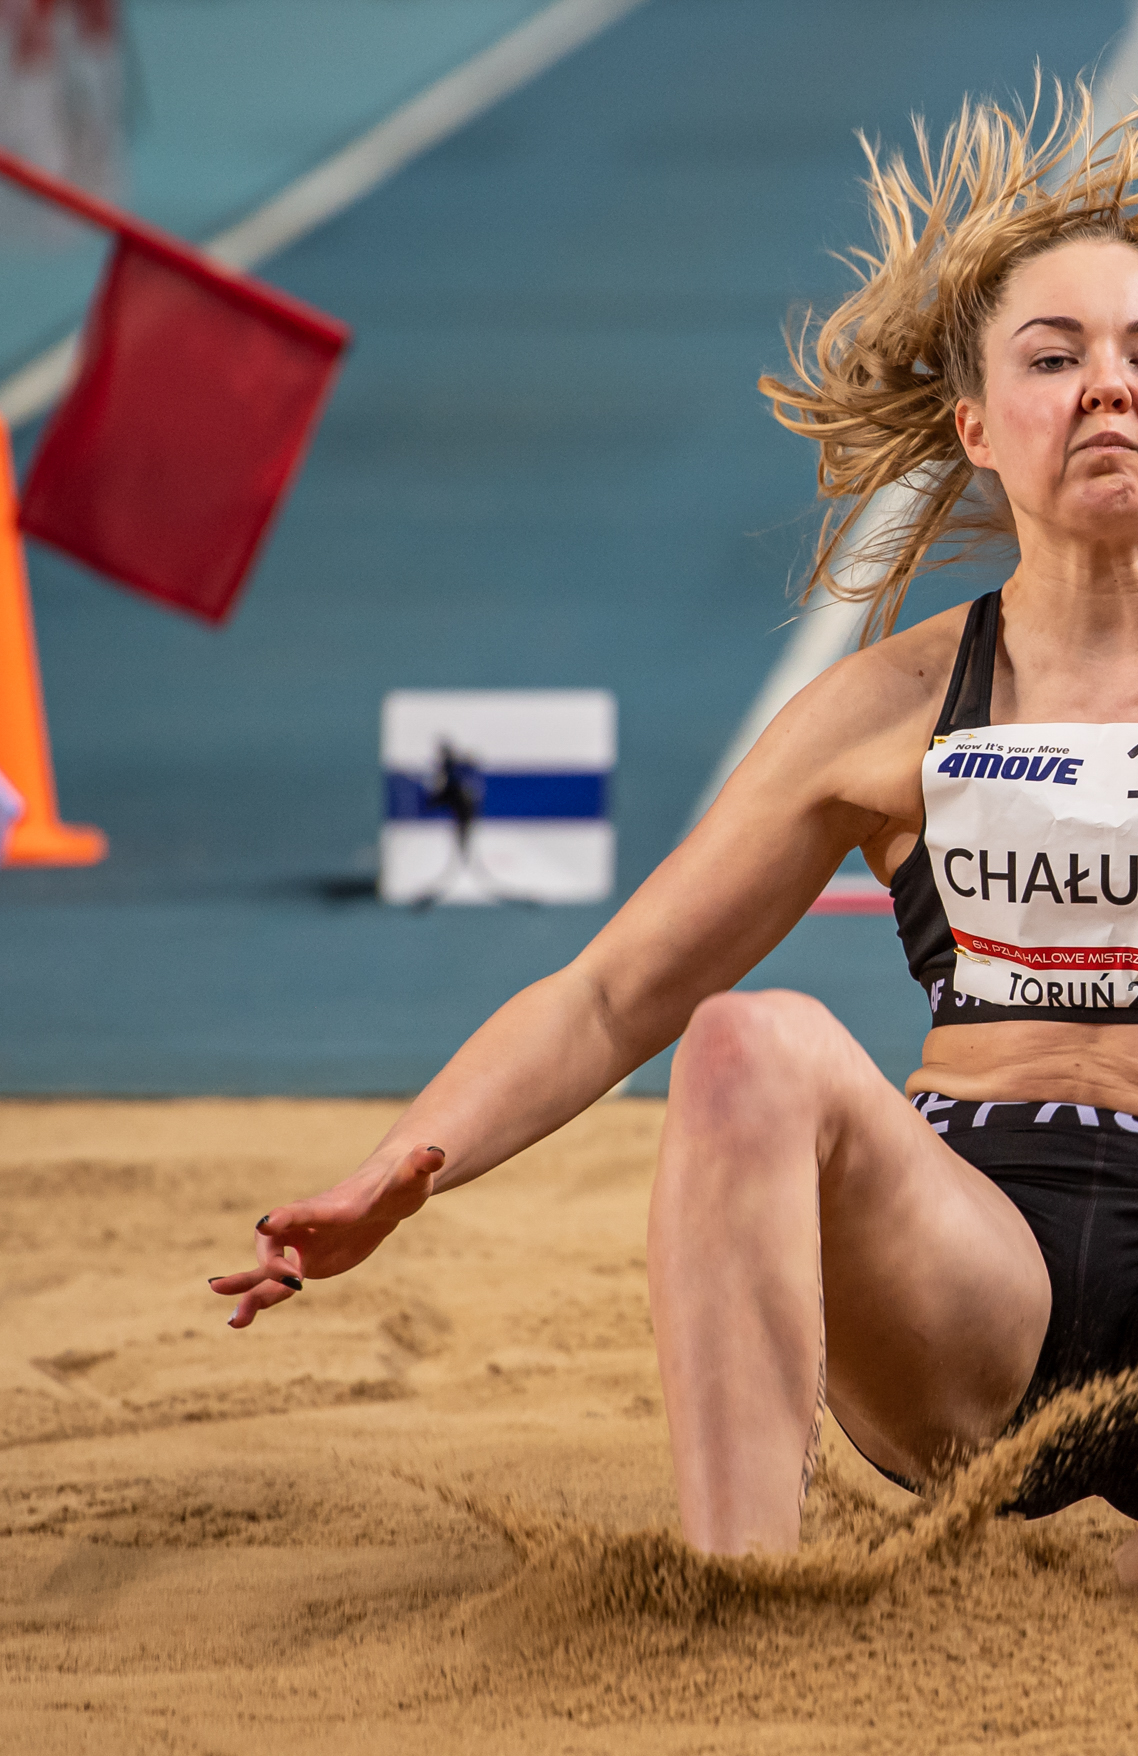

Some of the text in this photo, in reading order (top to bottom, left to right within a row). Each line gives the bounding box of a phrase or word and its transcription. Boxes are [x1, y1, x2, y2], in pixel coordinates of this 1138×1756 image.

[955, 742, 1070, 755] Now It's your Move
[937, 752, 1085, 786] 4MOVE
[1023, 953, 1085, 964] HALOWE
[1008, 972, 1115, 1008] TORUŃ
